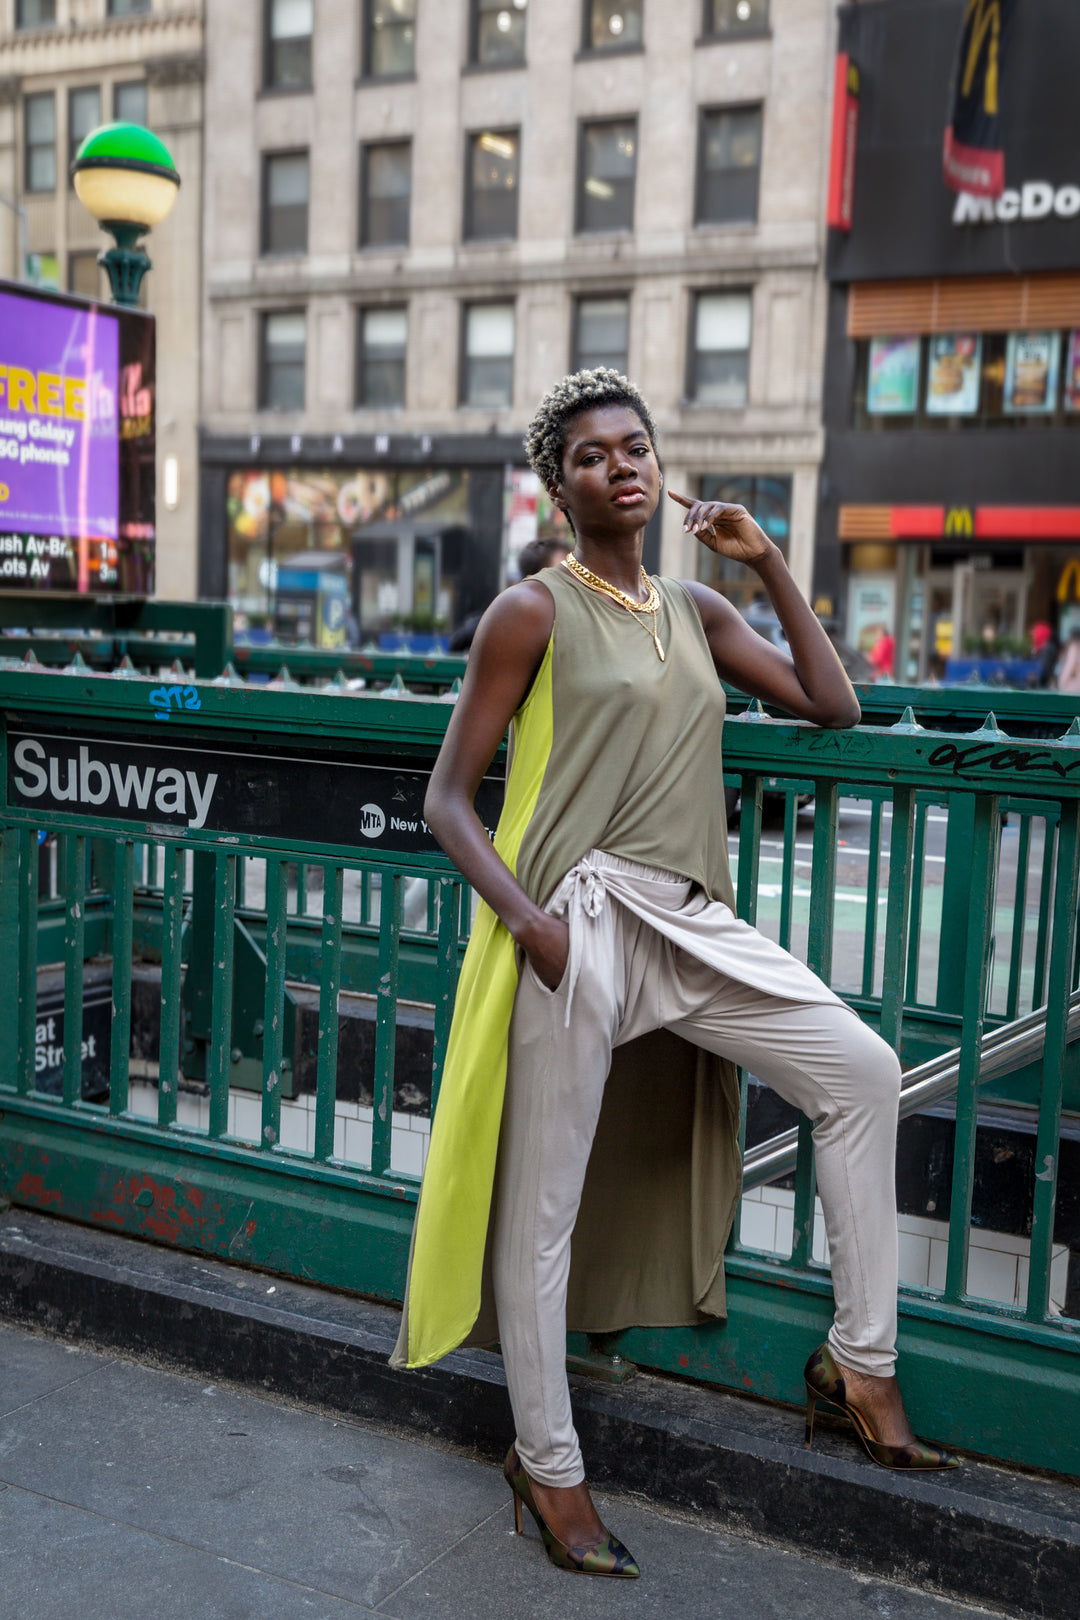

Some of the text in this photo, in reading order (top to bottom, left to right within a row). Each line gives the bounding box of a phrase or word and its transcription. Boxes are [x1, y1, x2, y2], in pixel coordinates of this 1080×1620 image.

[0, 365, 87, 420] REE
[20, 441, 70, 466] phones
[0, 558, 27, 577] ots
[30, 558, 50, 577] Av
[14, 739, 218, 828] Subway
[390, 817, 418, 832] New
[35, 1035, 96, 1072] Stret
